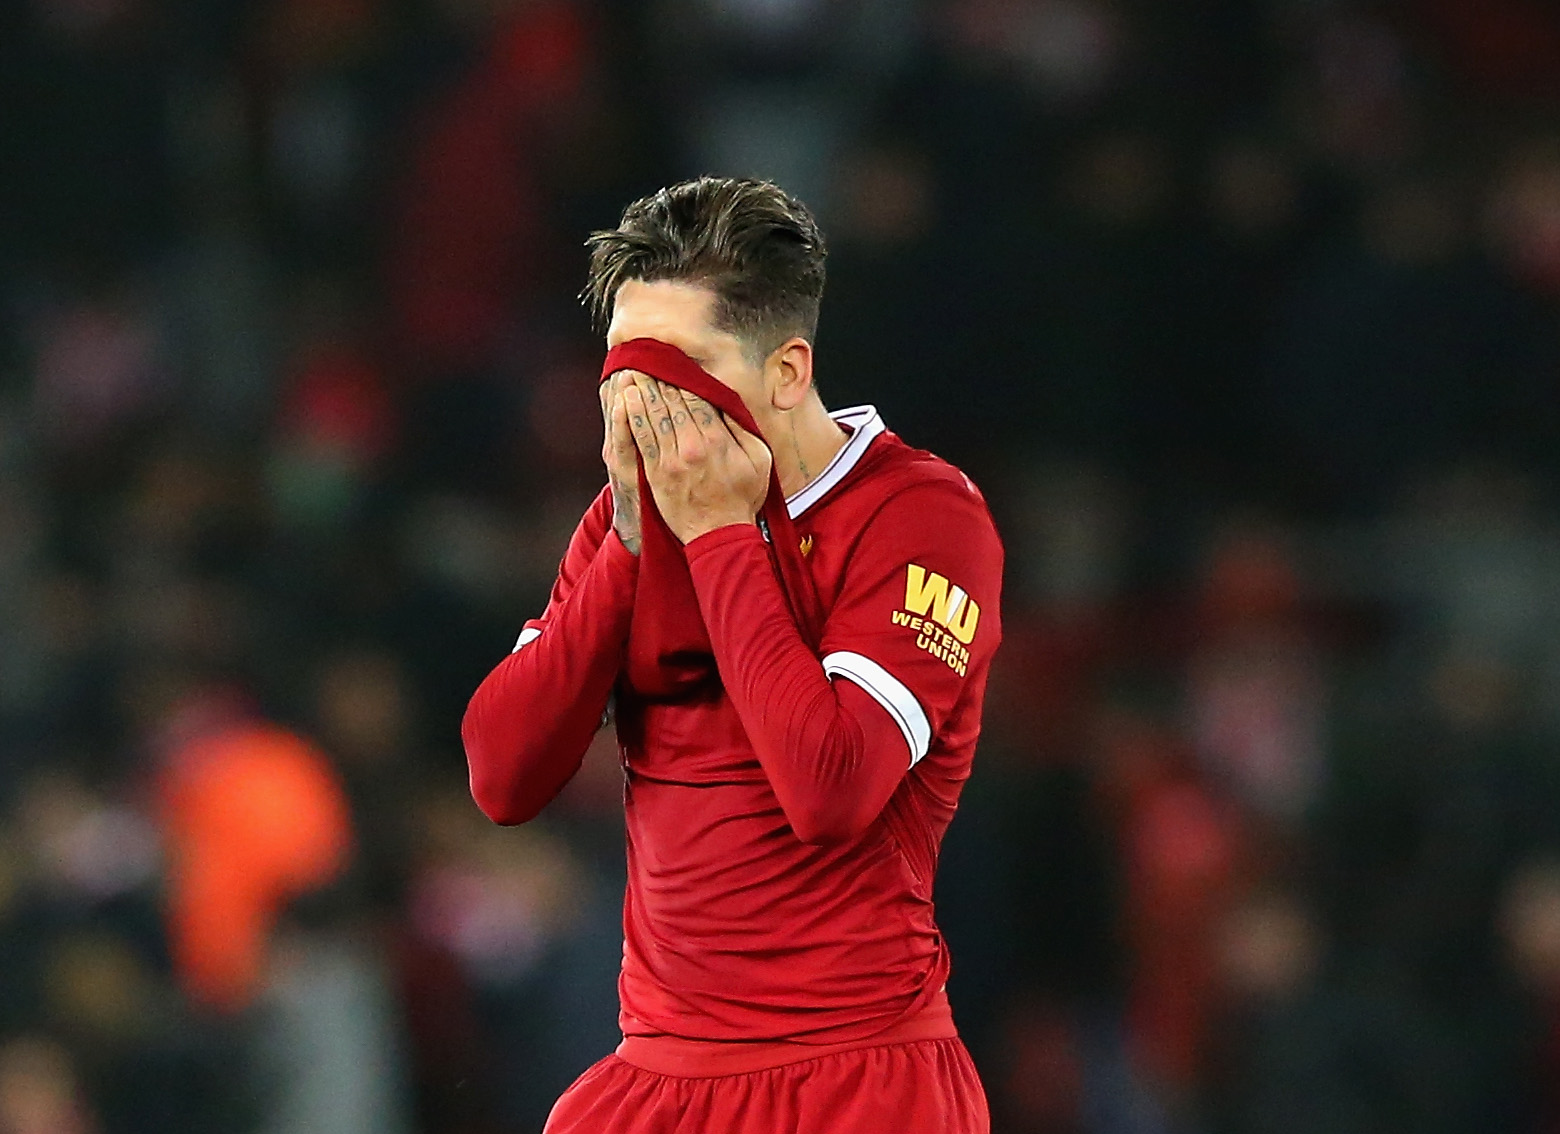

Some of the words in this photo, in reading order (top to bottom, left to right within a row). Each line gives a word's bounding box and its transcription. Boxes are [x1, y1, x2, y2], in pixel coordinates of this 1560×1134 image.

[905, 563, 981, 646] WU
[891, 610, 970, 664] WESTERN
[916, 633, 966, 677] UNION
